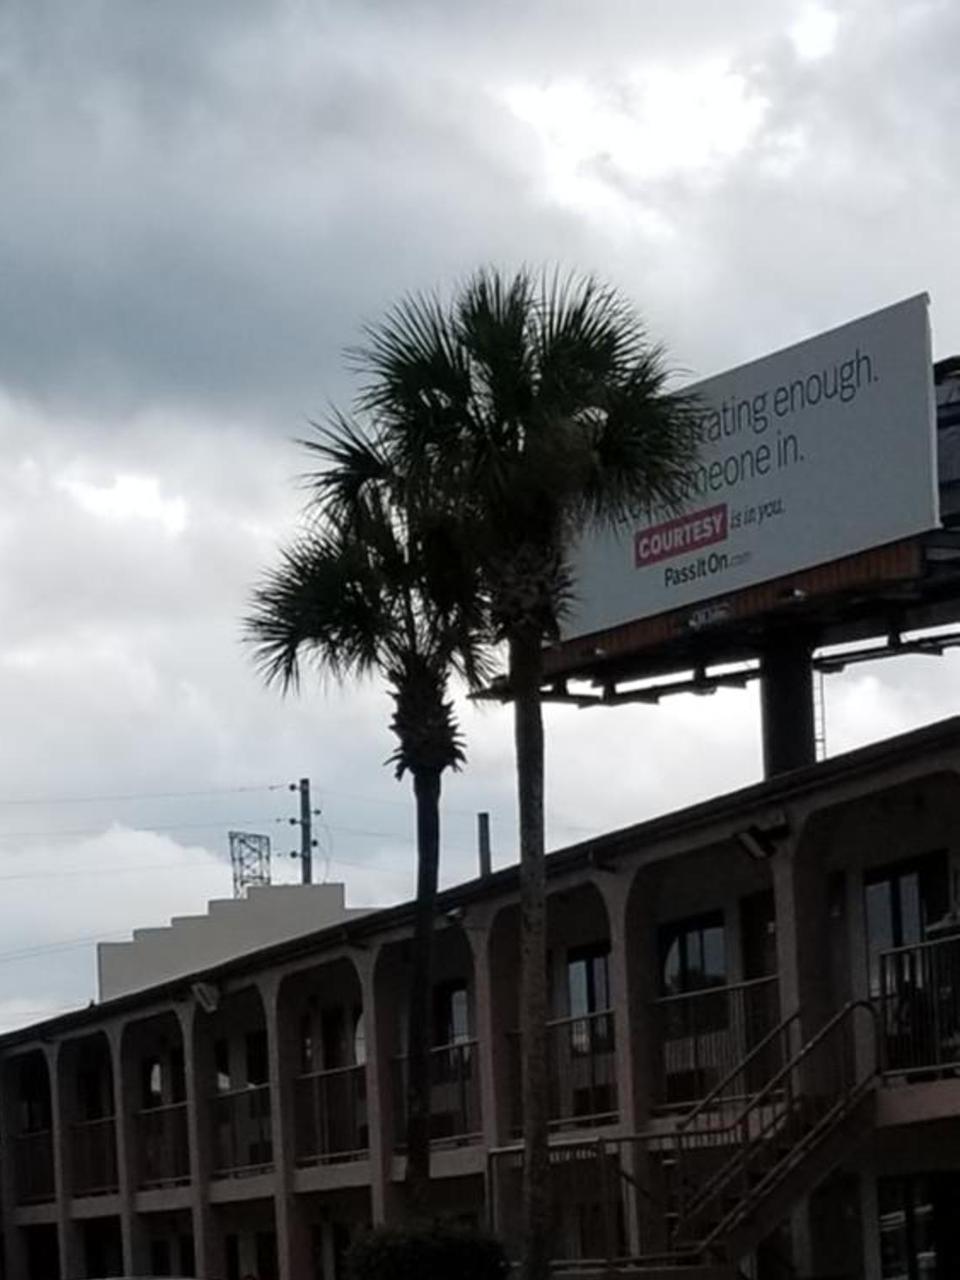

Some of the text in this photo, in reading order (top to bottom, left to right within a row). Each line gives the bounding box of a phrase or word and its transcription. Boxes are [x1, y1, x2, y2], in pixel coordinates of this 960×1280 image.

[707, 349, 879, 442] ating enough.
[777, 431, 804, 470] in.
[640, 512, 725, 559] COURTESY
[730, 508, 743, 529] is
